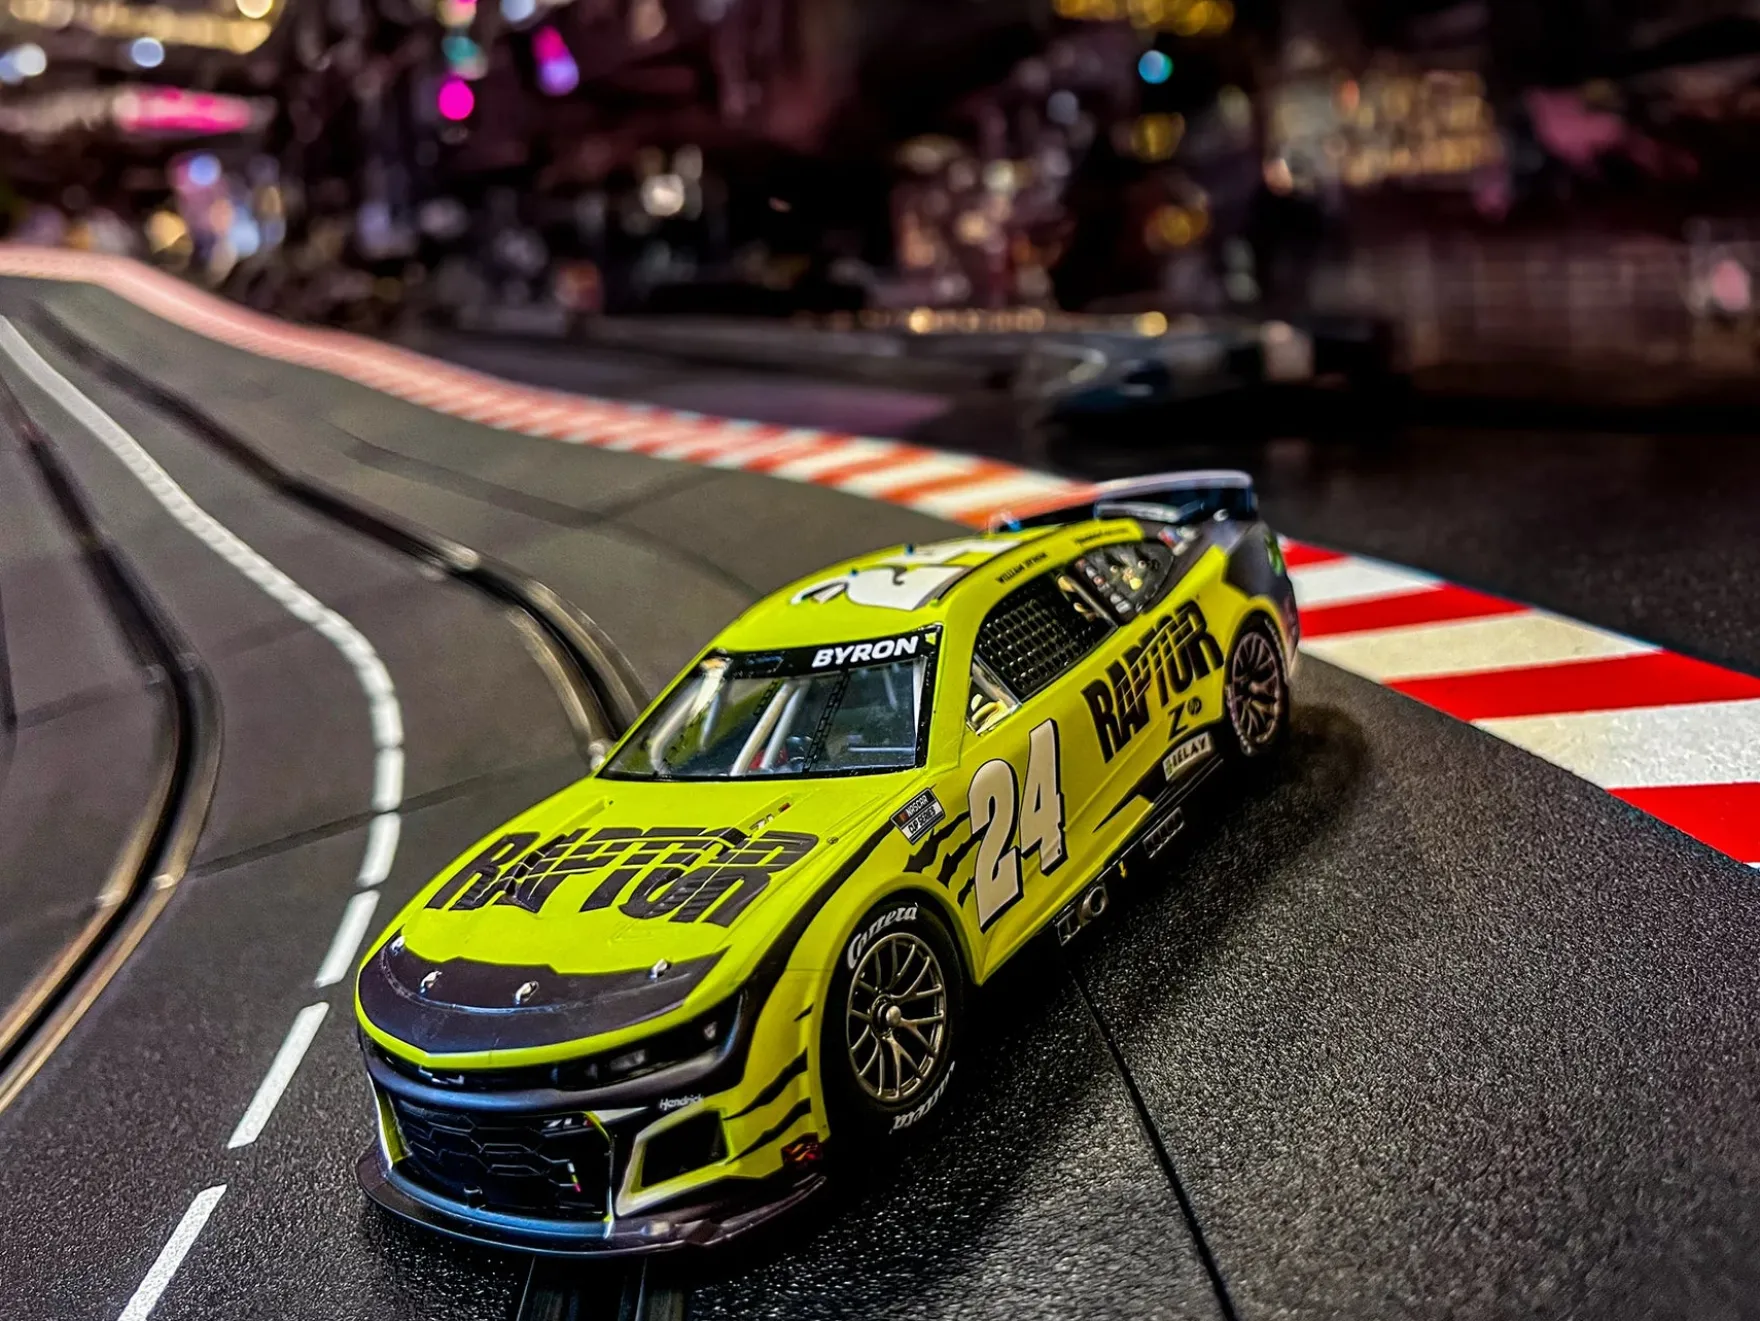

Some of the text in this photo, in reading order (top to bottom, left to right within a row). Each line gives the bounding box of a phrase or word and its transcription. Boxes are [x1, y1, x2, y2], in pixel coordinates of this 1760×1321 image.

[811, 636, 919, 668] BYRON
[1080, 600, 1225, 764] RAPTOR
[905, 795, 929, 817] NASCAR
[907, 805, 936, 834] CUP SERIES
[967, 718, 1068, 934] 24
[424, 827, 818, 928] RAPTOR
[847, 902, 918, 969] Carrera
